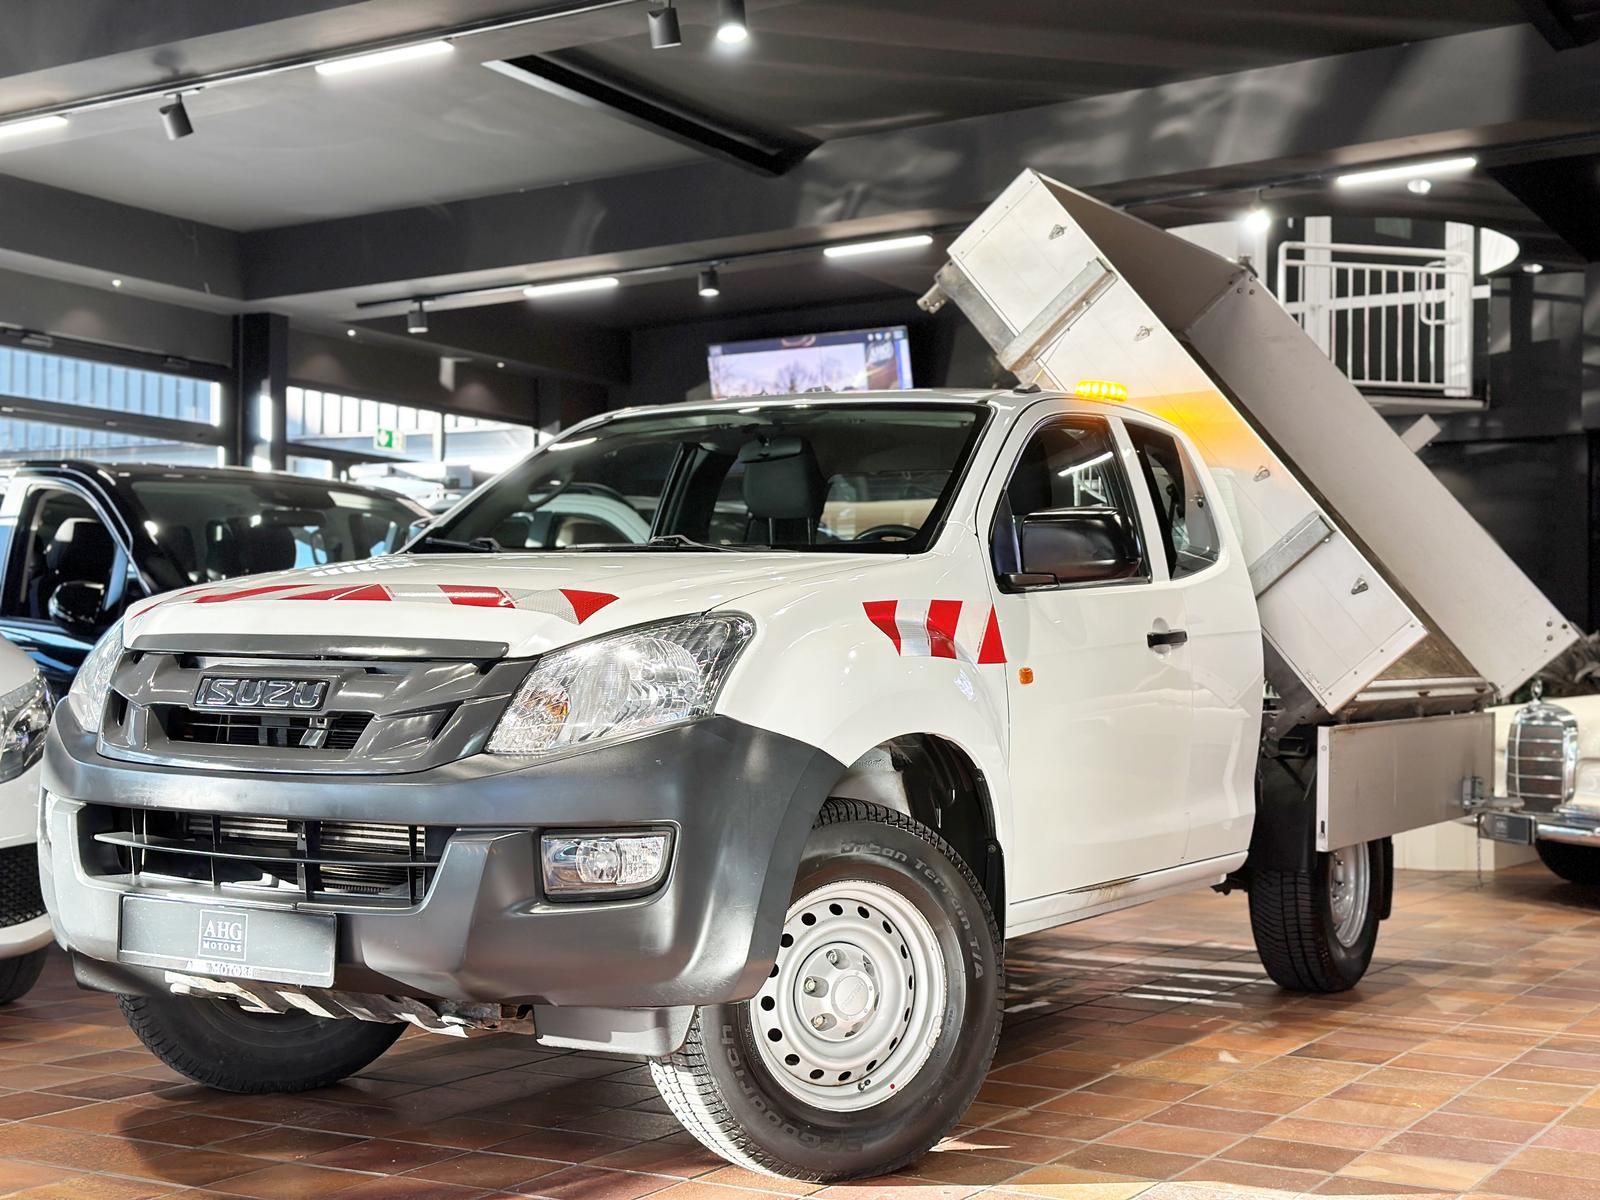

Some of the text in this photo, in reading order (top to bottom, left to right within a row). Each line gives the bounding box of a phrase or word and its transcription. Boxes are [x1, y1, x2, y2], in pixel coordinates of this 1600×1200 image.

[195, 678, 326, 708] ISUZU
[203, 919, 243, 941] AHG
[914, 858, 971, 931] Terrain
[968, 936, 985, 980] T/A
[202, 940, 243, 953] MOTORS
